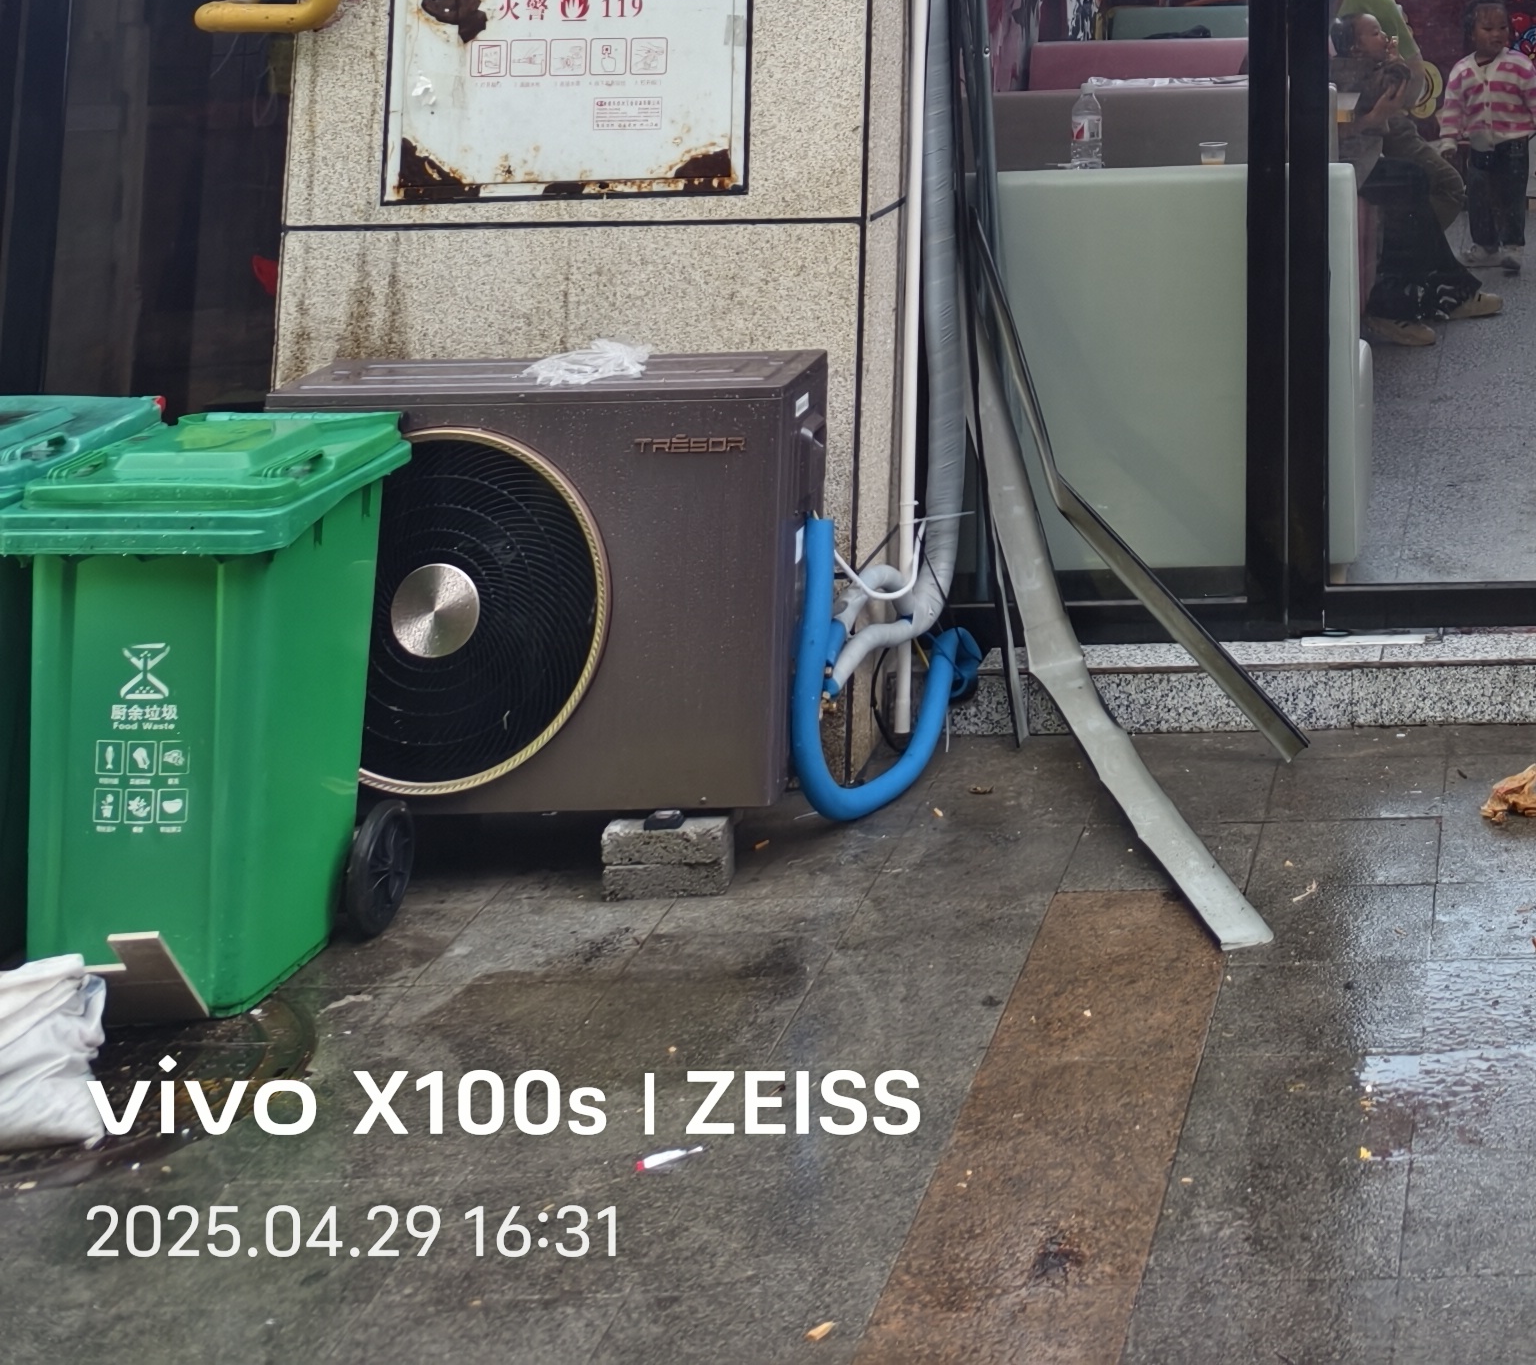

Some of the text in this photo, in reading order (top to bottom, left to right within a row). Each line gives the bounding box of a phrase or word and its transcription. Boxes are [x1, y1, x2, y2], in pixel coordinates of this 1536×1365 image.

[110, 704, 179, 721] 厨余垃圾
[112, 722, 176, 731] Food Waste
